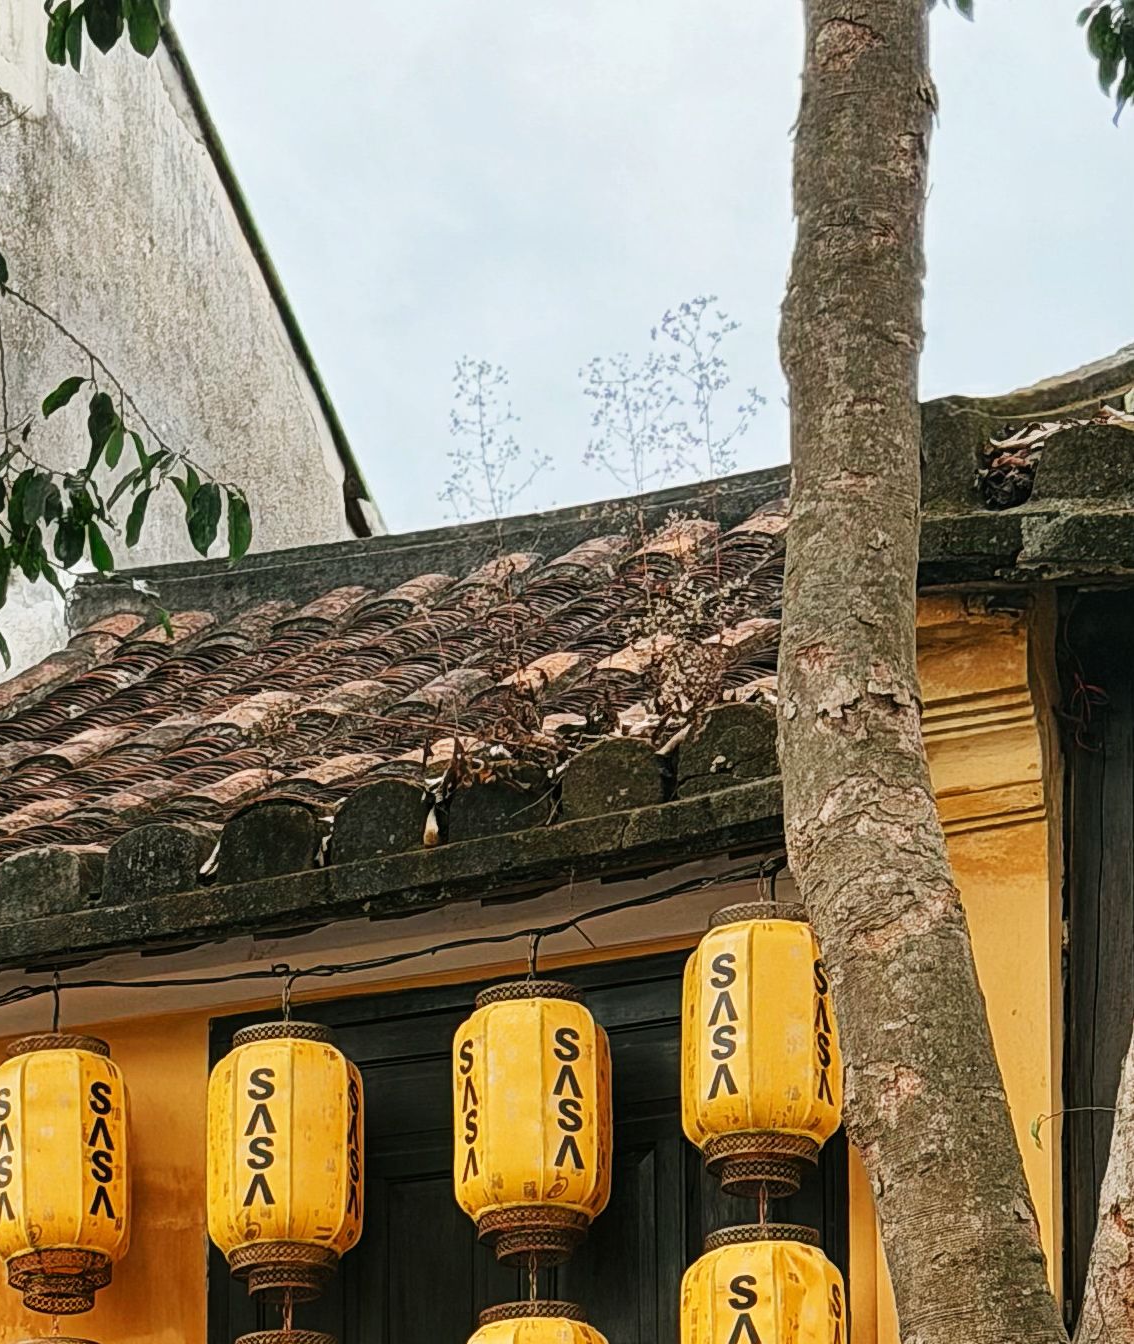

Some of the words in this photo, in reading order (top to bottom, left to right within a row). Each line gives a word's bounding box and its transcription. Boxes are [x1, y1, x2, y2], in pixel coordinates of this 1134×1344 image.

[707, 952, 739, 1101] SASA
[88, 1081, 115, 1219] SASA
[244, 1068, 276, 1208] SASA
[459, 1039, 479, 1183] SASA
[553, 1027, 585, 1170] SASA
